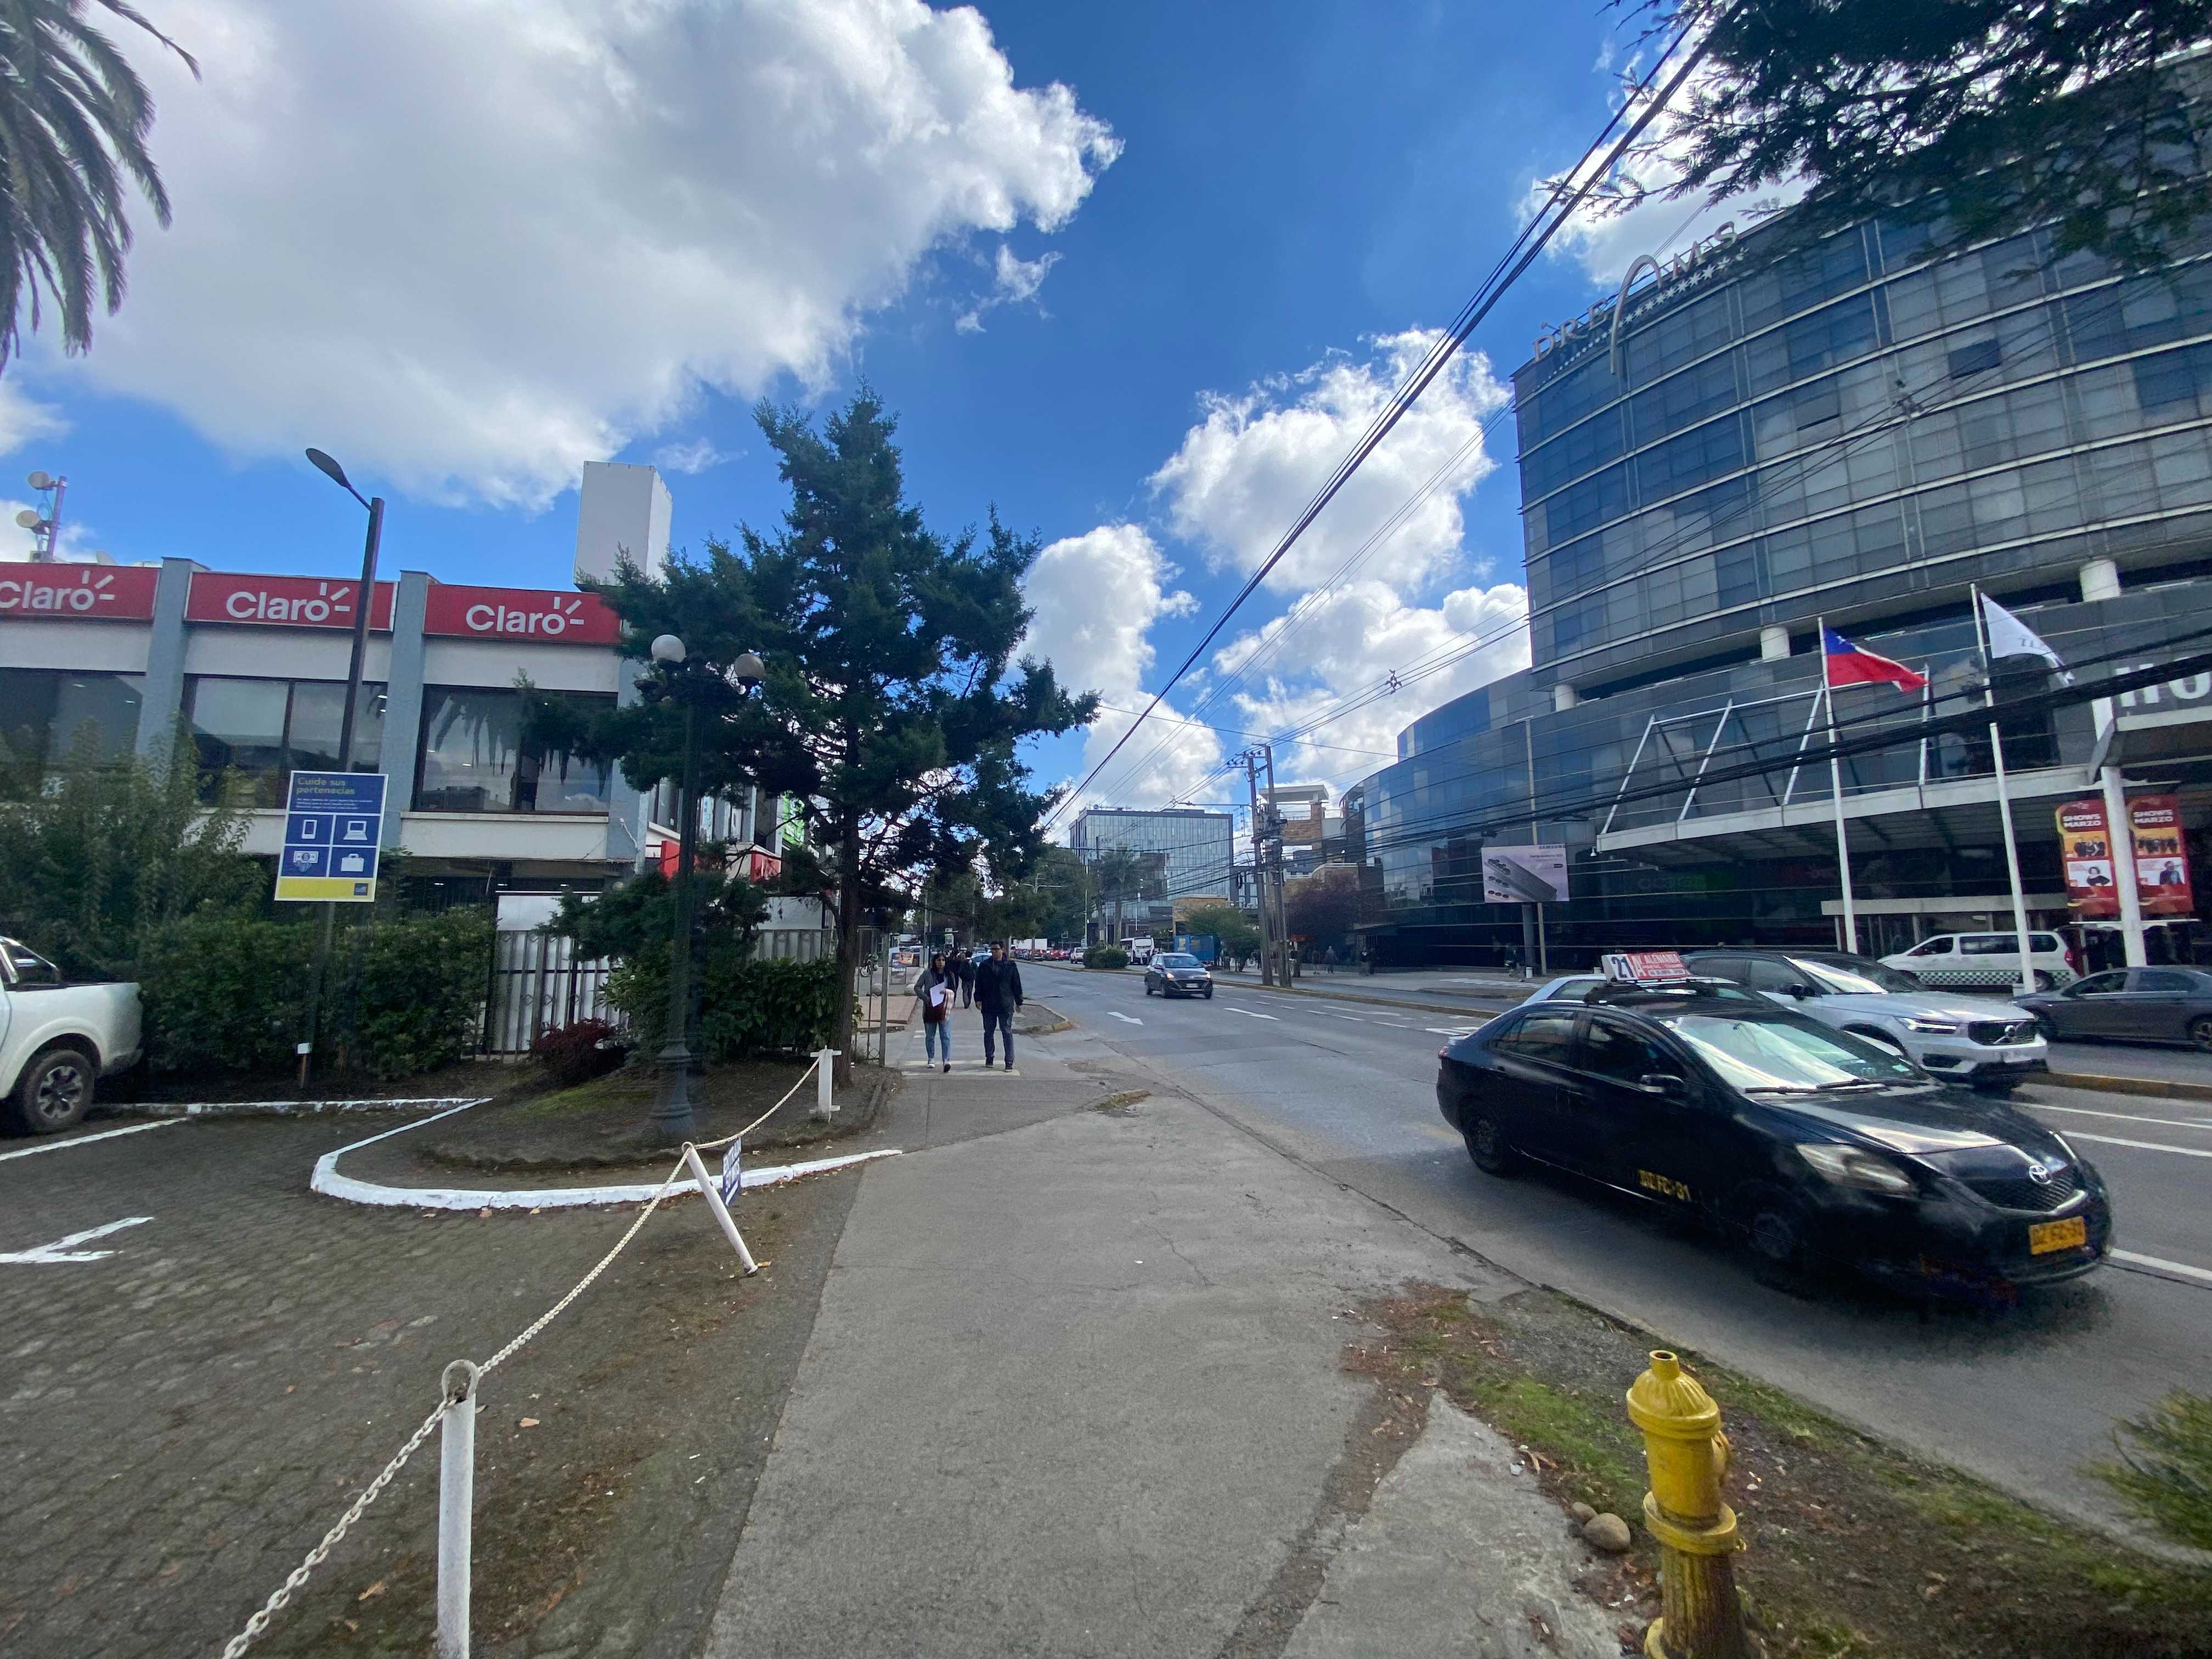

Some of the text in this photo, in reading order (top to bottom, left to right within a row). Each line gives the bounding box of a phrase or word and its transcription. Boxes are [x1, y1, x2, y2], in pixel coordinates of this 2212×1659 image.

[0, 580, 94, 611] Claro
[226, 591, 330, 622] Claro
[466, 604, 565, 635] Claro
[297, 777, 326, 786] Cuide
[2062, 813, 2101, 822] SHOWS
[2133, 809, 2173, 818] SHOWS
[2063, 820, 2102, 828] MARZO
[2134, 816, 2174, 824] MARZO
